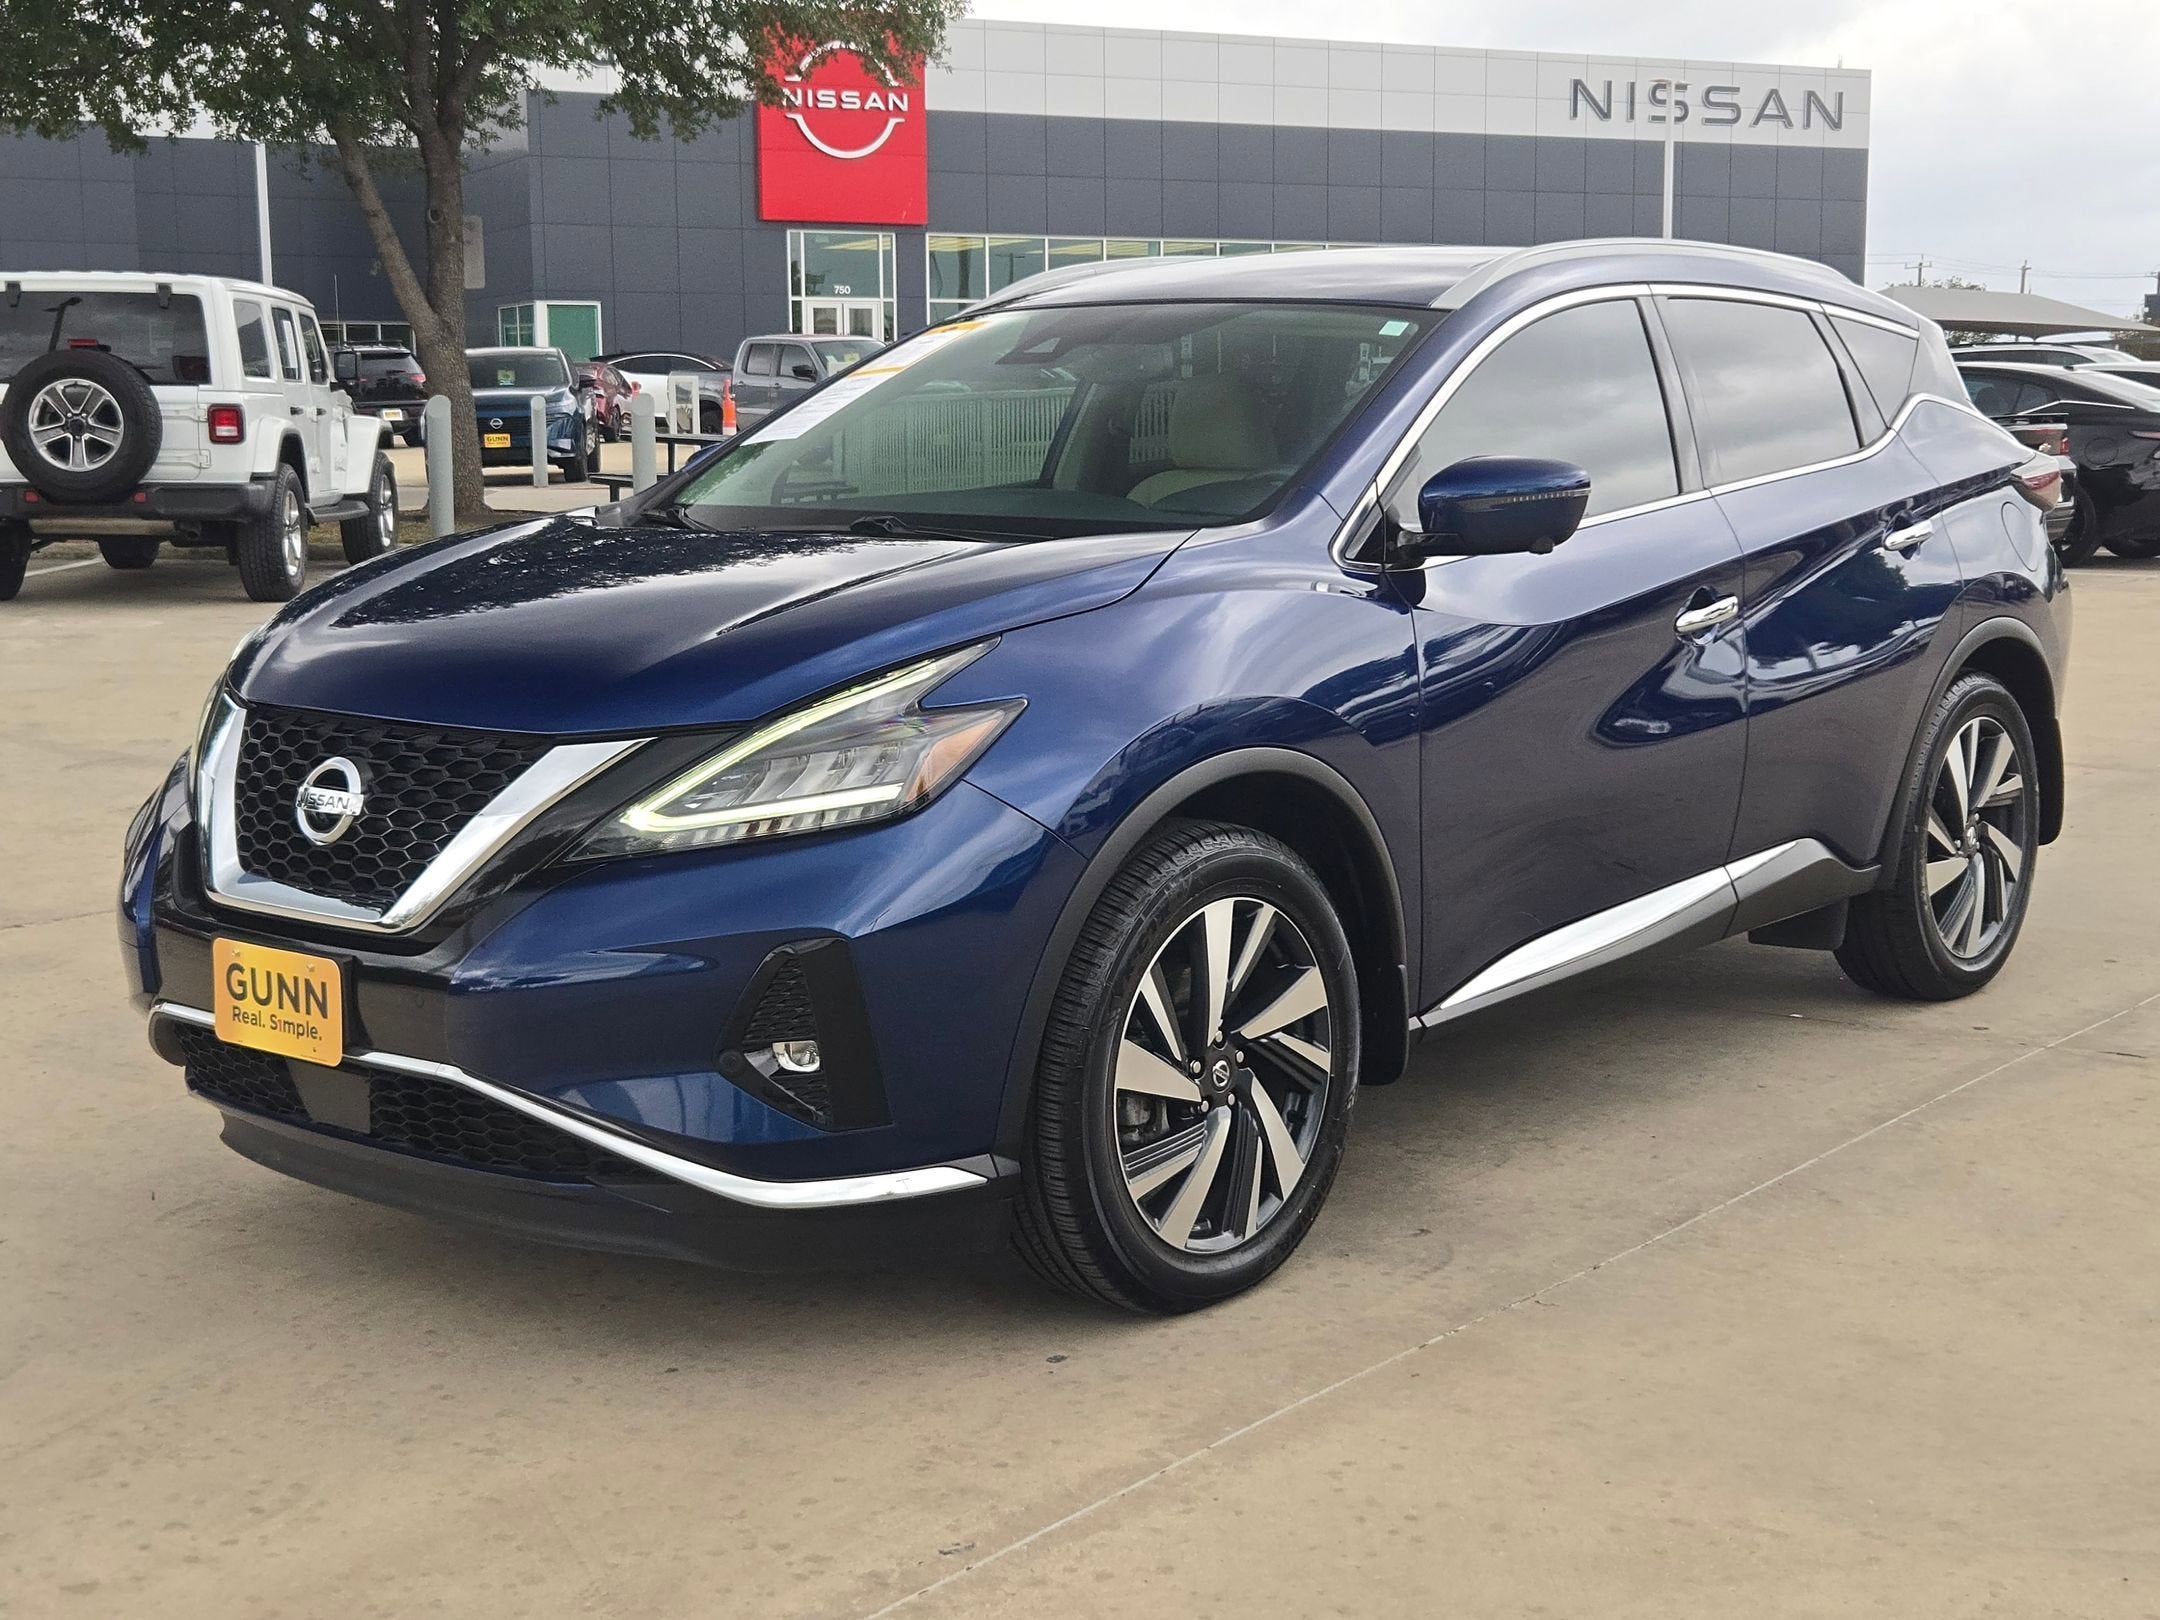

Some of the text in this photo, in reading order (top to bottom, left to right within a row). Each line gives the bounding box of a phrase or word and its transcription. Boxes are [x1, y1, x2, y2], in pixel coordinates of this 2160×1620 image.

[782, 87, 909, 112] NISSAN
[1570, 79, 1844, 131] NISSAN
[833, 285, 852, 295] 750
[225, 962, 328, 1020] GUNN
[231, 1005, 266, 1029] Real.
